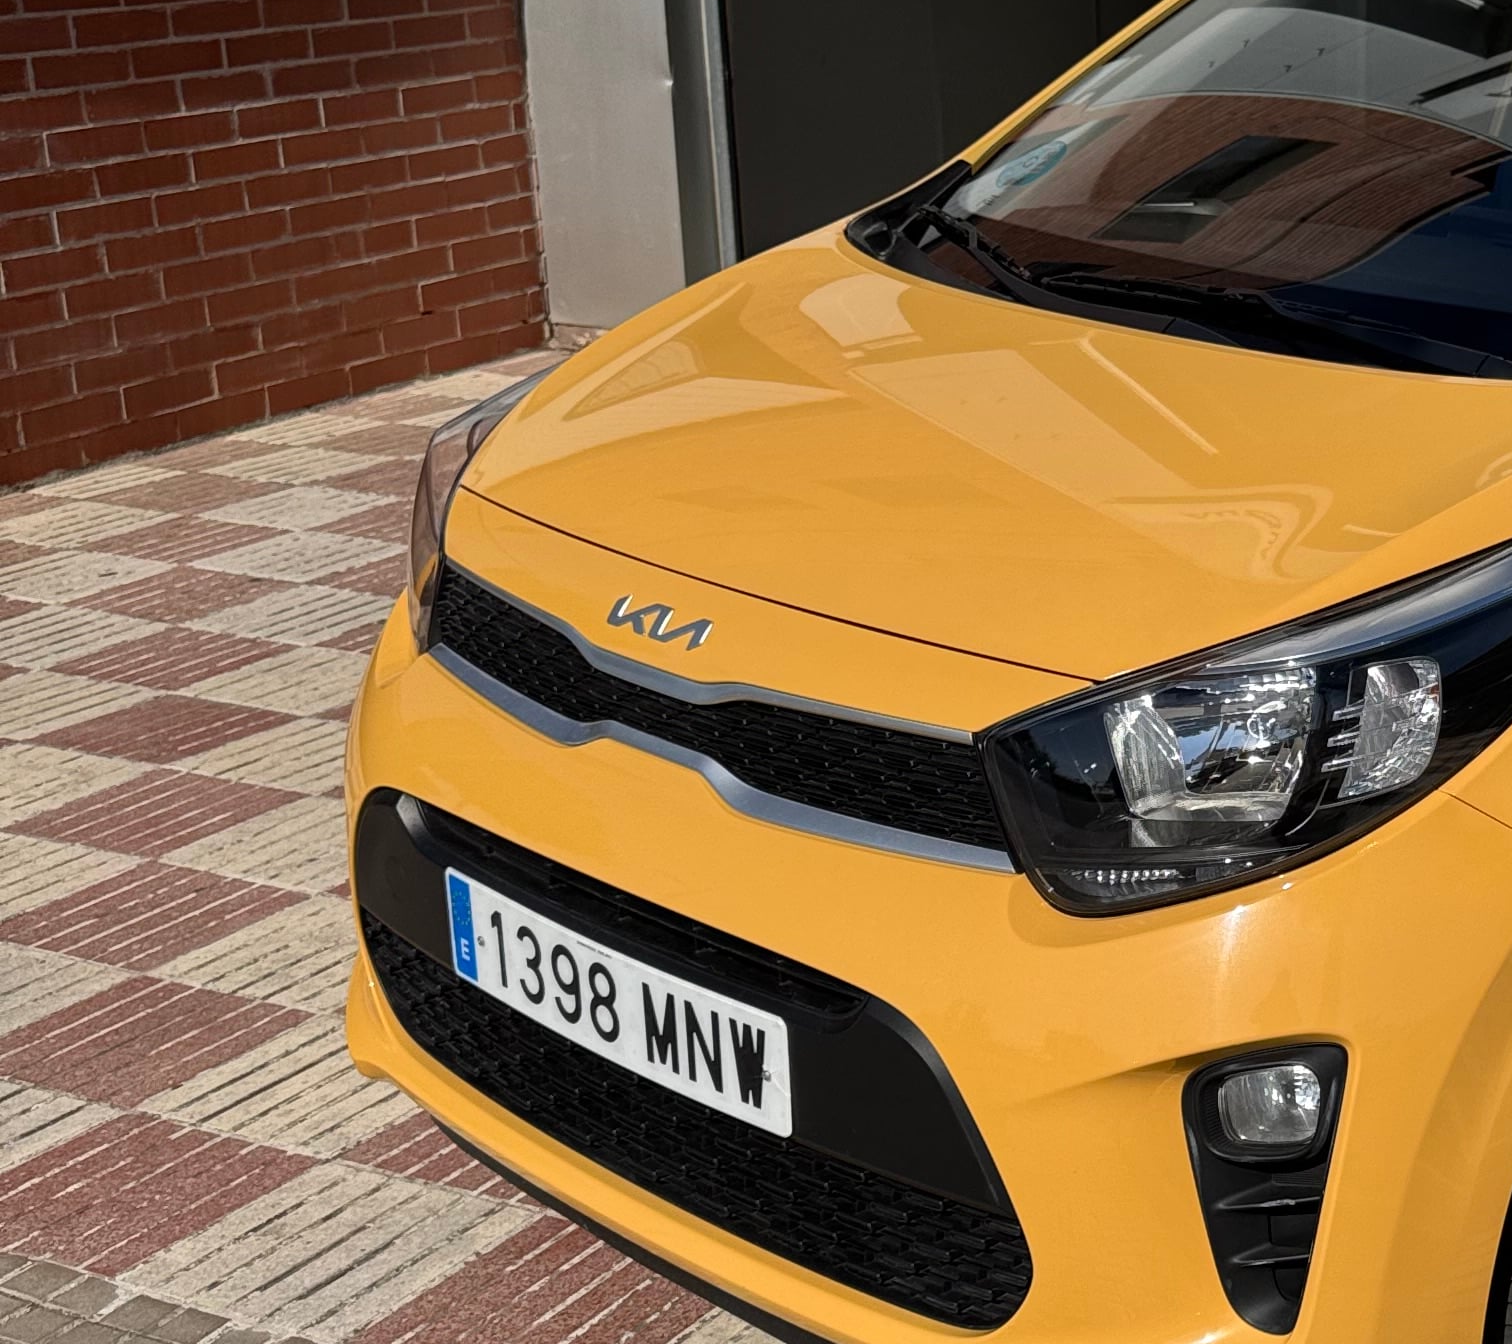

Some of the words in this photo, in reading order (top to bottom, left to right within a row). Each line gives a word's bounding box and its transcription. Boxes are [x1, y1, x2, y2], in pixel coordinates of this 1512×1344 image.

[607, 593, 714, 651] KIA
[460, 937, 471, 962] E
[490, 910, 621, 1043] 1398
[641, 981, 767, 1110] MNW
